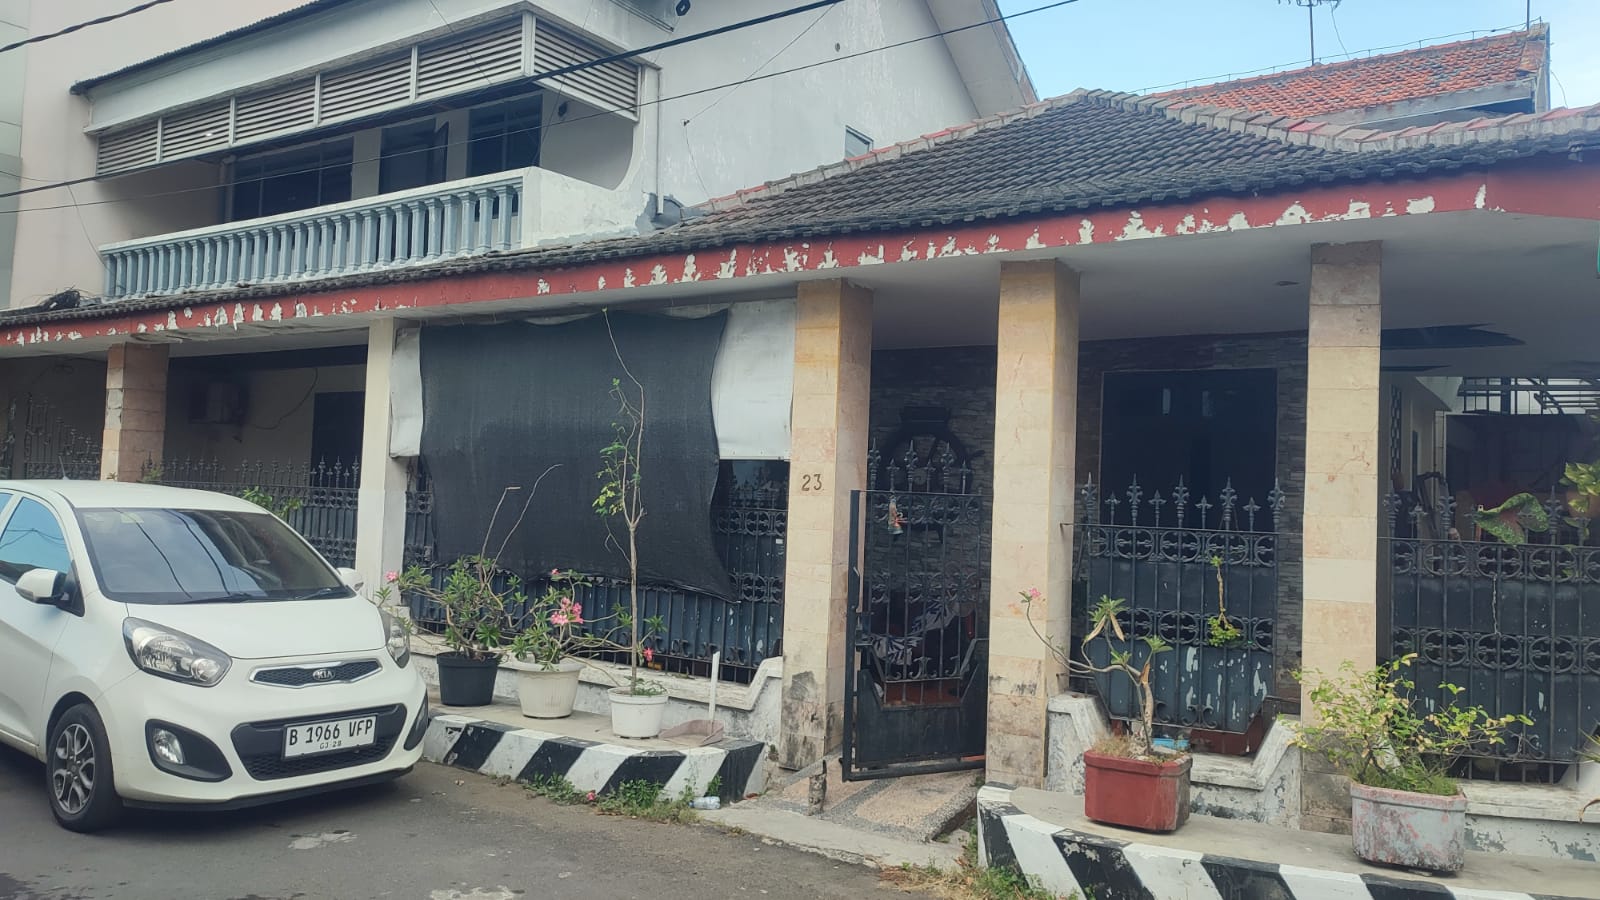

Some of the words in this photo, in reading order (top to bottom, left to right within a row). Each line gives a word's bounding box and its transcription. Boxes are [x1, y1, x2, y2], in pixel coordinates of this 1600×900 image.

[801, 473, 823, 491] 23
[289, 729, 298, 745] B
[305, 723, 340, 744] 1966
[348, 719, 373, 737] VFP
